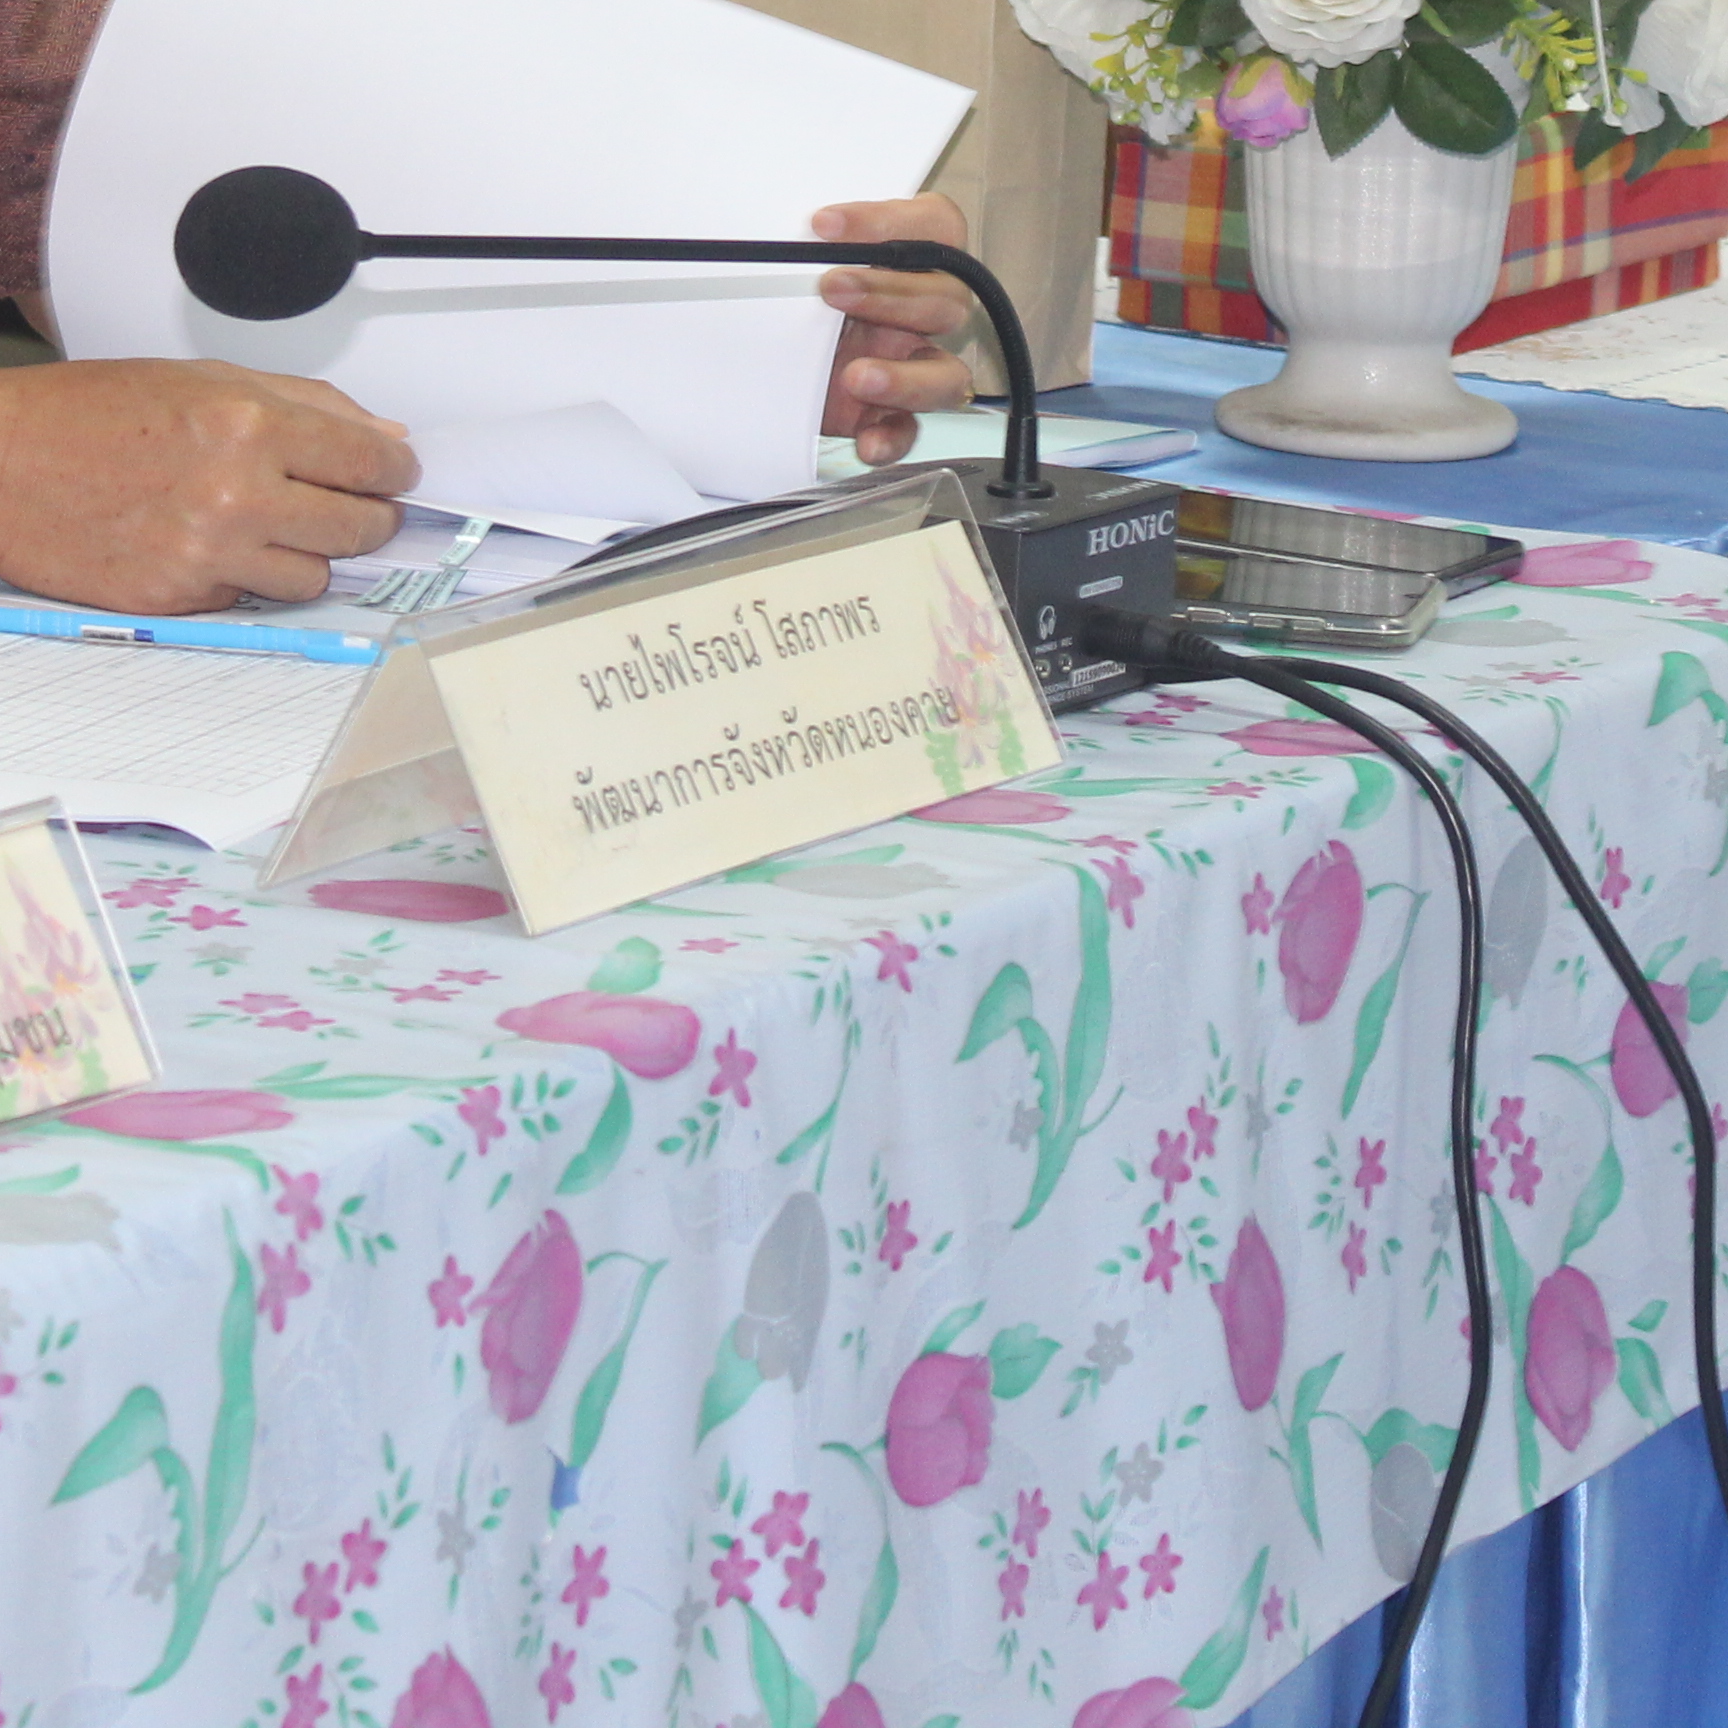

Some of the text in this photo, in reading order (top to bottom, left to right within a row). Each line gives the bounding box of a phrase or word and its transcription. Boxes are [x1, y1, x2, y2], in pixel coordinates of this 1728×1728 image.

[579, 595, 882, 711] นายไพโรจน์ โสภาพร
[571, 685, 962, 834] พัฒนาการจังหวัดหนองคาย
